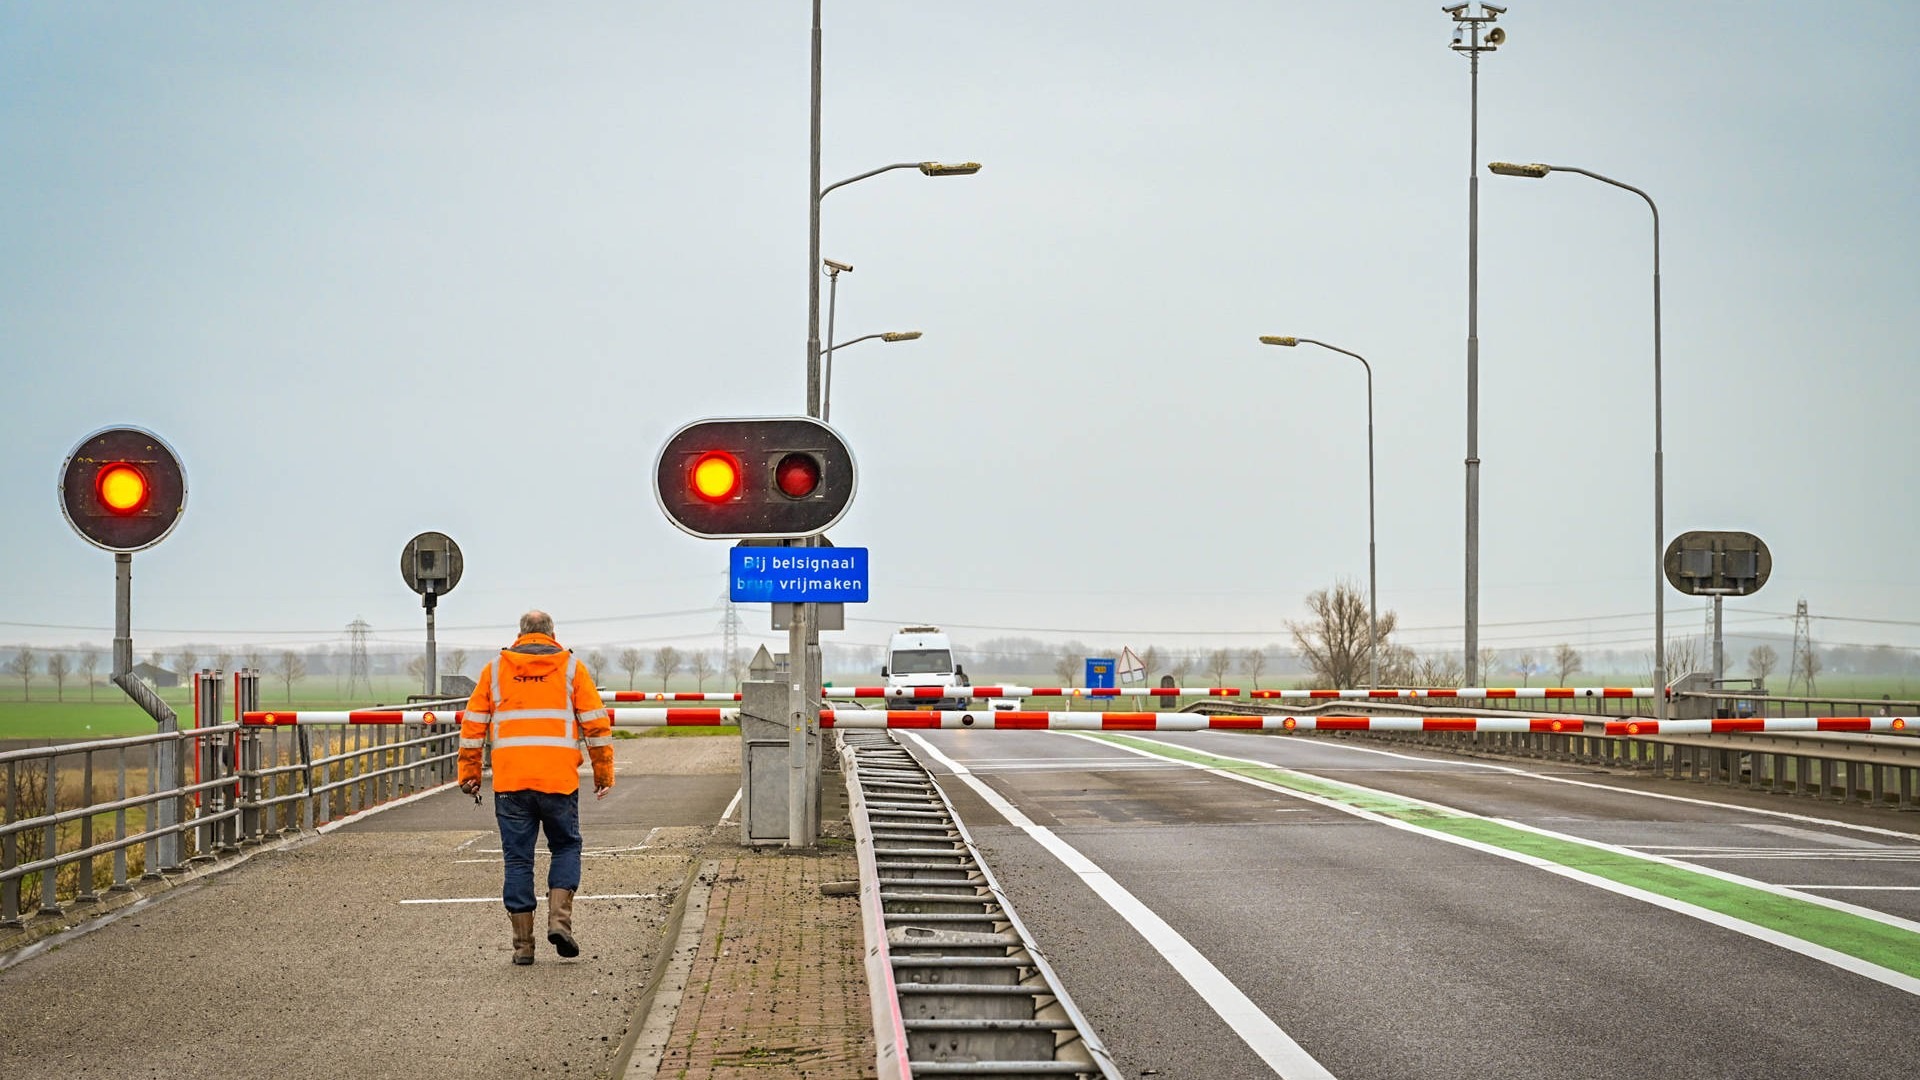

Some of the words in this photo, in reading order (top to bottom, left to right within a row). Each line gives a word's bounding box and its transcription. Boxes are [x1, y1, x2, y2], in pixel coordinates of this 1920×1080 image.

[744, 556, 766, 573] Bij
[773, 556, 855, 573] belsignaal
[737, 577, 773, 593] brug
[779, 577, 862, 594] vrijmaken
